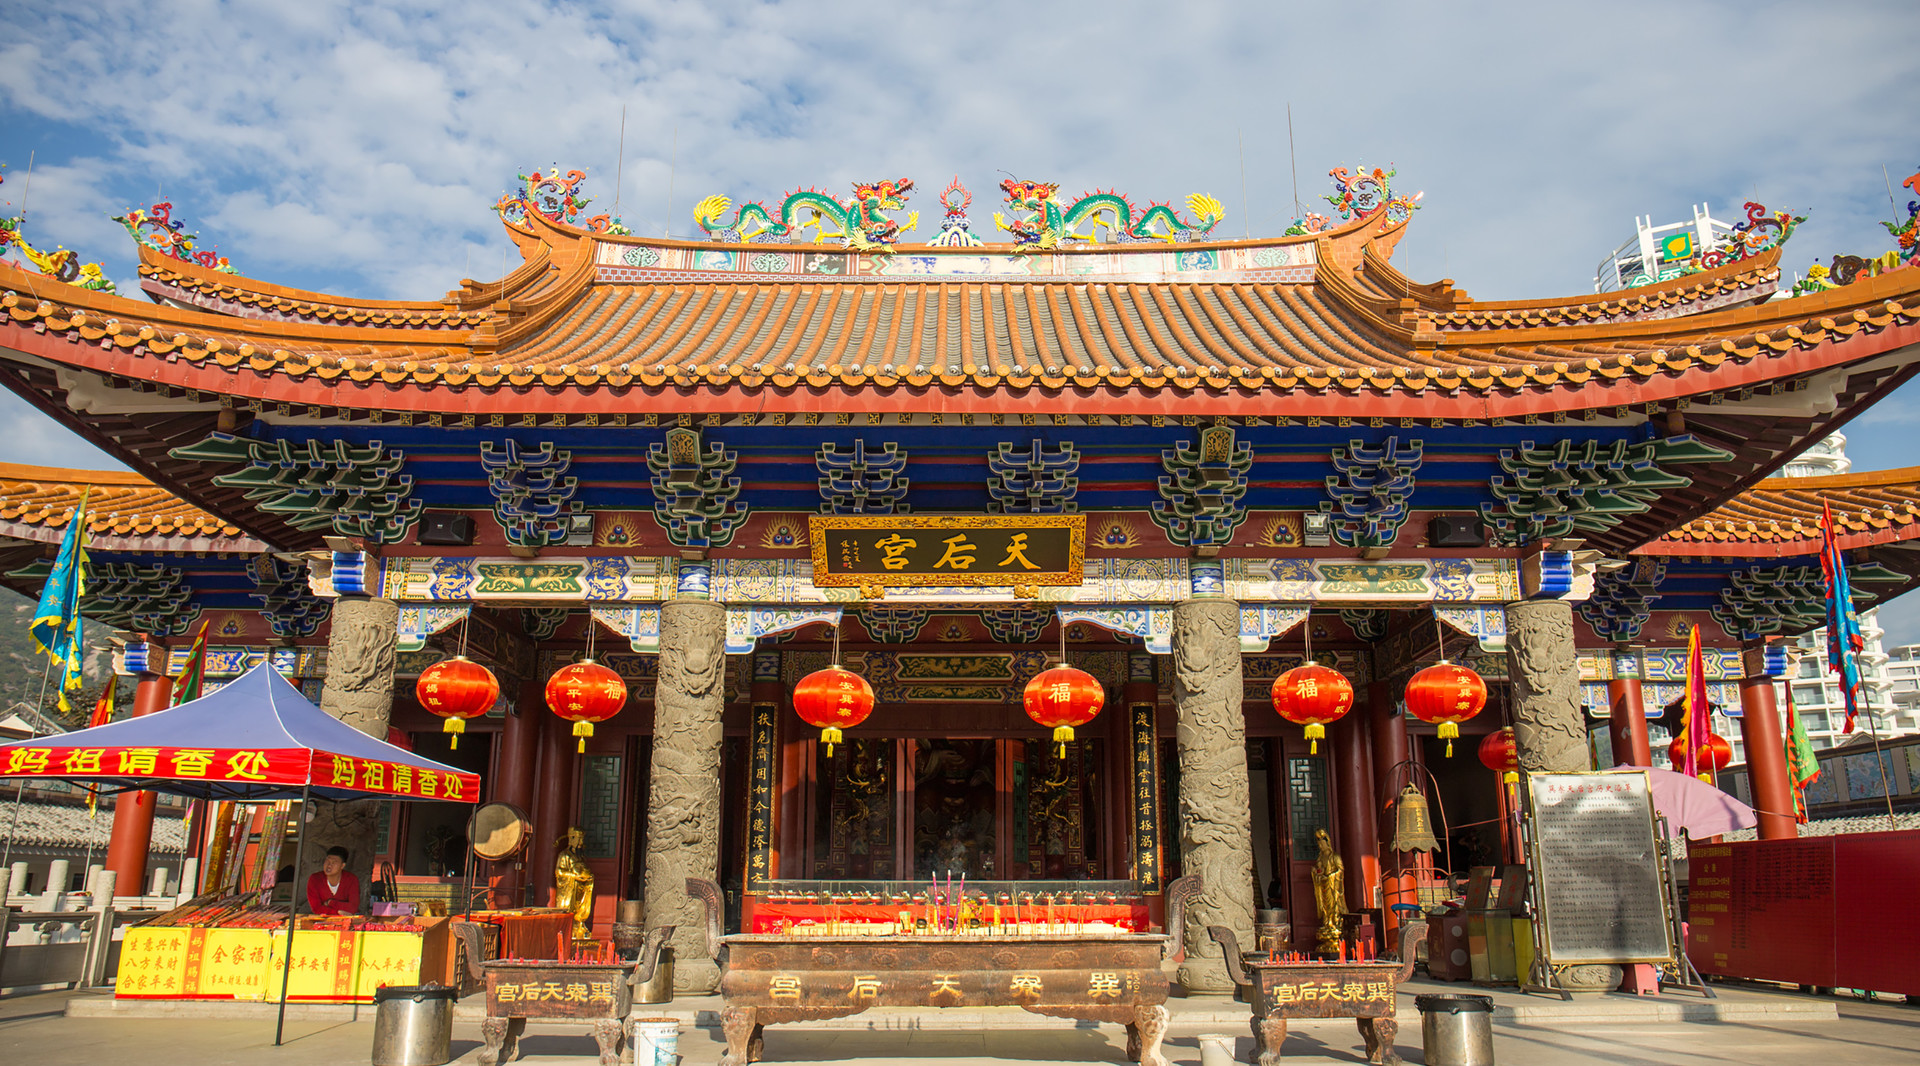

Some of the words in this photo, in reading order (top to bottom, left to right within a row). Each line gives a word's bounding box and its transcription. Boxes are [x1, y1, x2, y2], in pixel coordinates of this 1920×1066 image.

[566, 667, 584, 711] 出入平安
[604, 679, 621, 700] 福
[1048, 683, 1071, 703] 福
[1296, 678, 1318, 699] 福
[9, 747, 270, 781] 妈祖请香处
[332, 755, 464, 800] 妈祖请香处
[130, 937, 181, 951] 生意兴隆
[126, 956, 178, 970] 八方来财
[185, 936, 203, 992] 妈祖赐福
[211, 946, 264, 965] 全家福
[336, 938, 352, 995] 妈祖赐福
[122, 974, 176, 990] 合家平安
